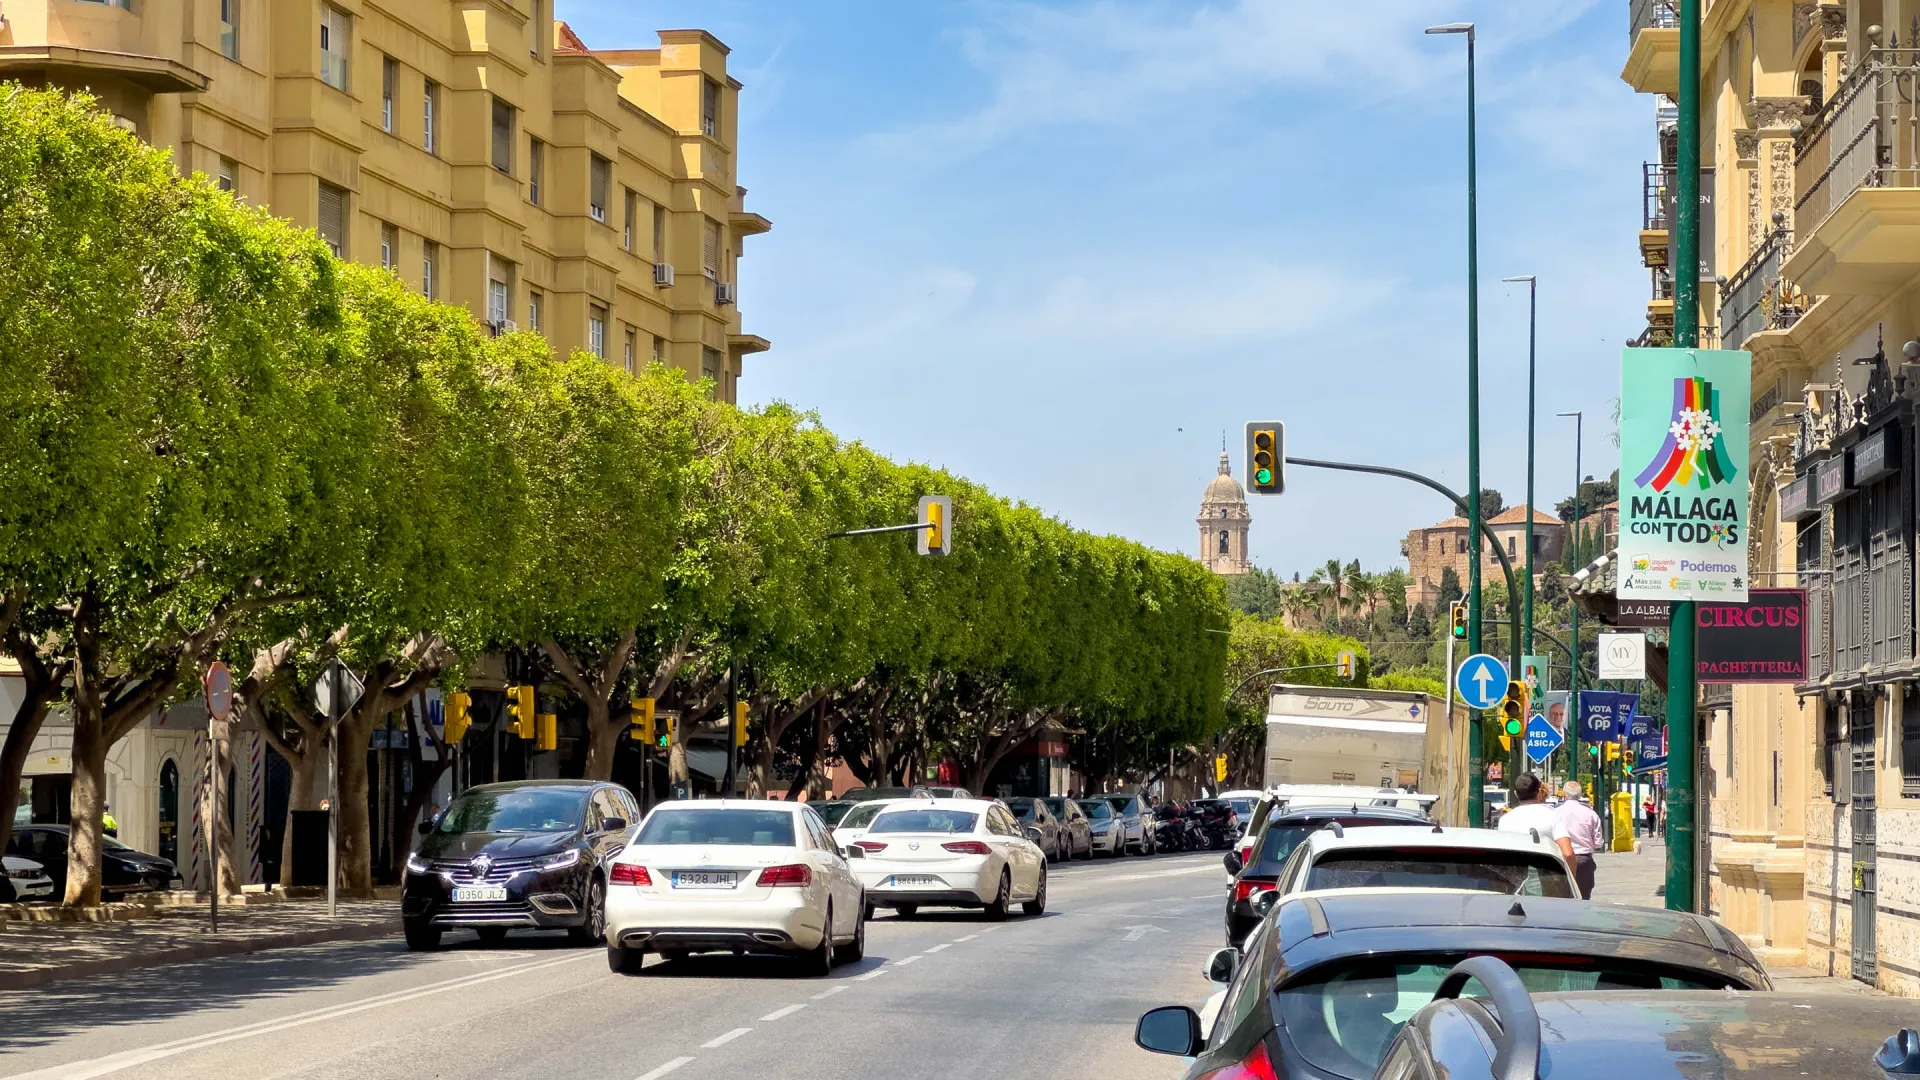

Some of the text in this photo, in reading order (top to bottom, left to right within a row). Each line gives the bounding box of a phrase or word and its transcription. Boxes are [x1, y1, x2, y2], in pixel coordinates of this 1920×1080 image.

[1631, 491, 1738, 521] MÁLAGA
[1631, 522, 1661, 534] CON
[1680, 560, 1737, 573] Podemos
[1620, 605, 1634, 615] LA
[1697, 606, 1800, 627] CIRCUS
[1612, 647, 1632, 658] MY
[1588, 705, 1612, 713] VOTA
[1528, 739, 1555, 747] ÁSICA
[678, 788, 685, 798] P
[680, 874, 733, 884] 6328 JHL
[459, 890, 504, 900] 0350 JLZ
